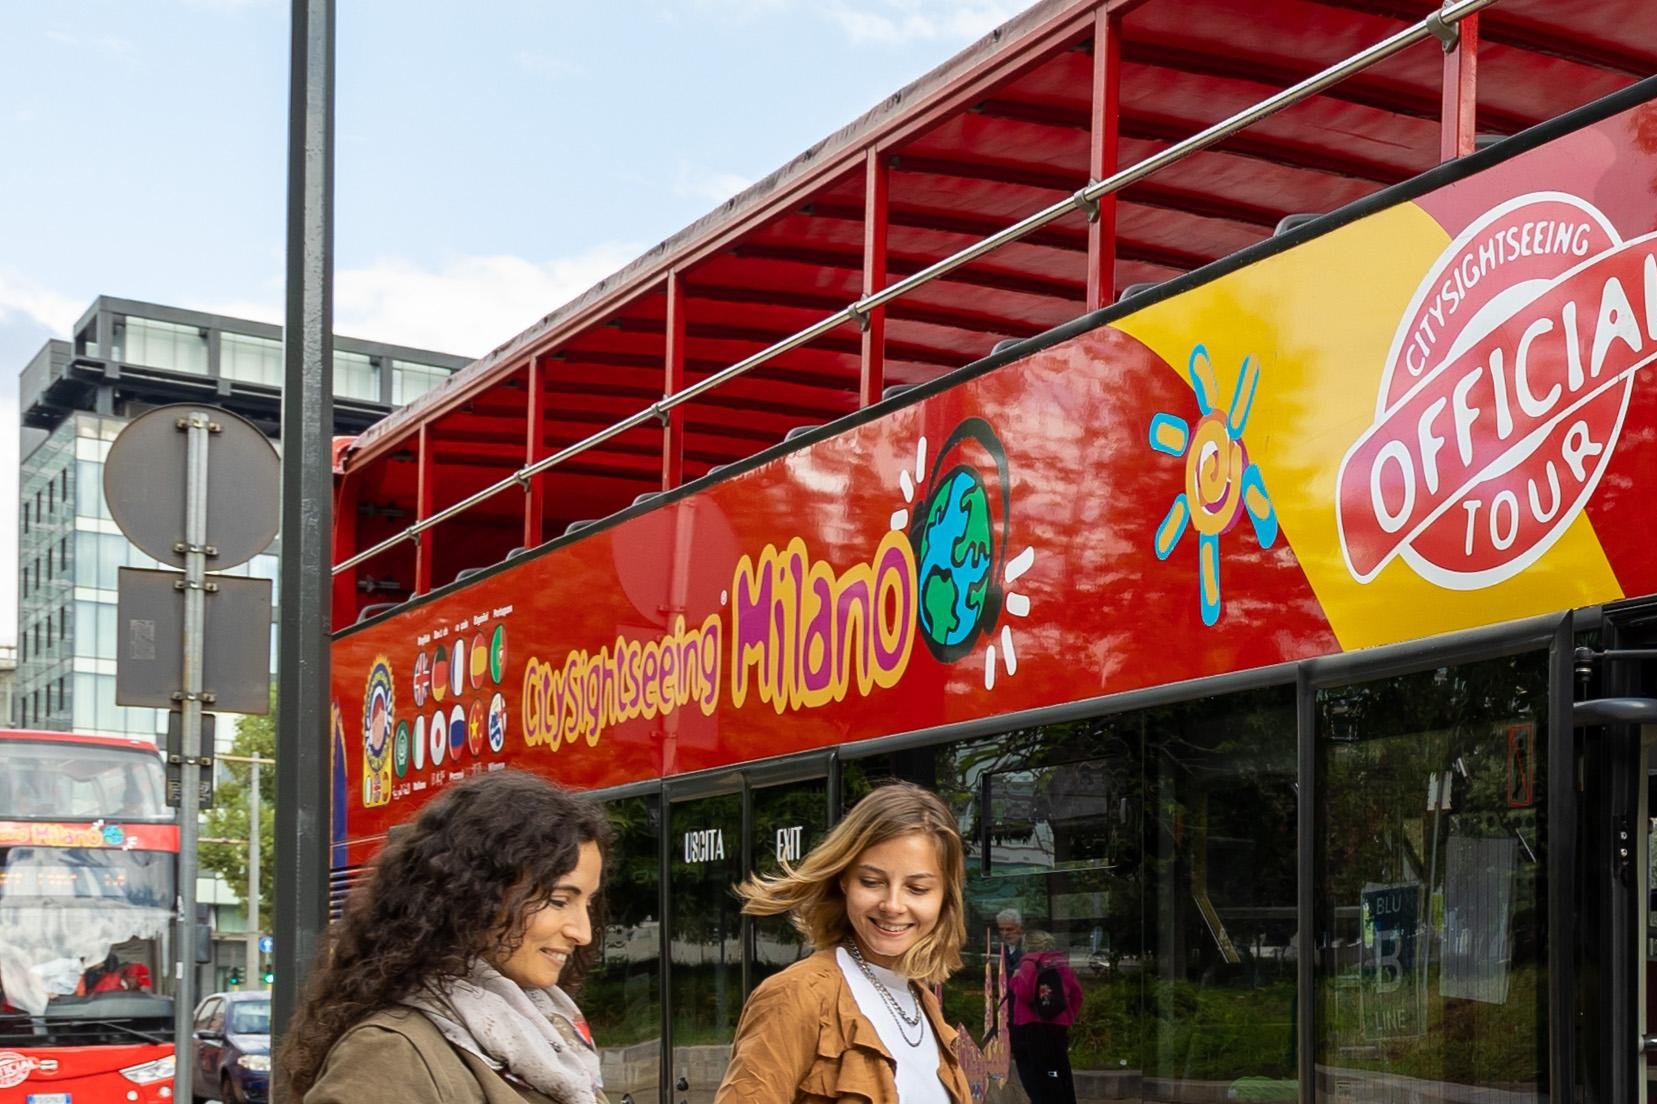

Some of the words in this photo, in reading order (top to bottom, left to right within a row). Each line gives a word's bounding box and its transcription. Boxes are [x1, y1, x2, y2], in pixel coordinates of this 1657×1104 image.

[1405, 220, 1591, 377] CITYSIGHTSEEING
[1462, 420, 1602, 556] TOUR
[731, 529, 918, 715] Milano
[684, 828, 725, 864] USCITA
[776, 826, 803, 862] EXIT
[1376, 894, 1401, 915] BLU
[1375, 930, 1403, 993] B
